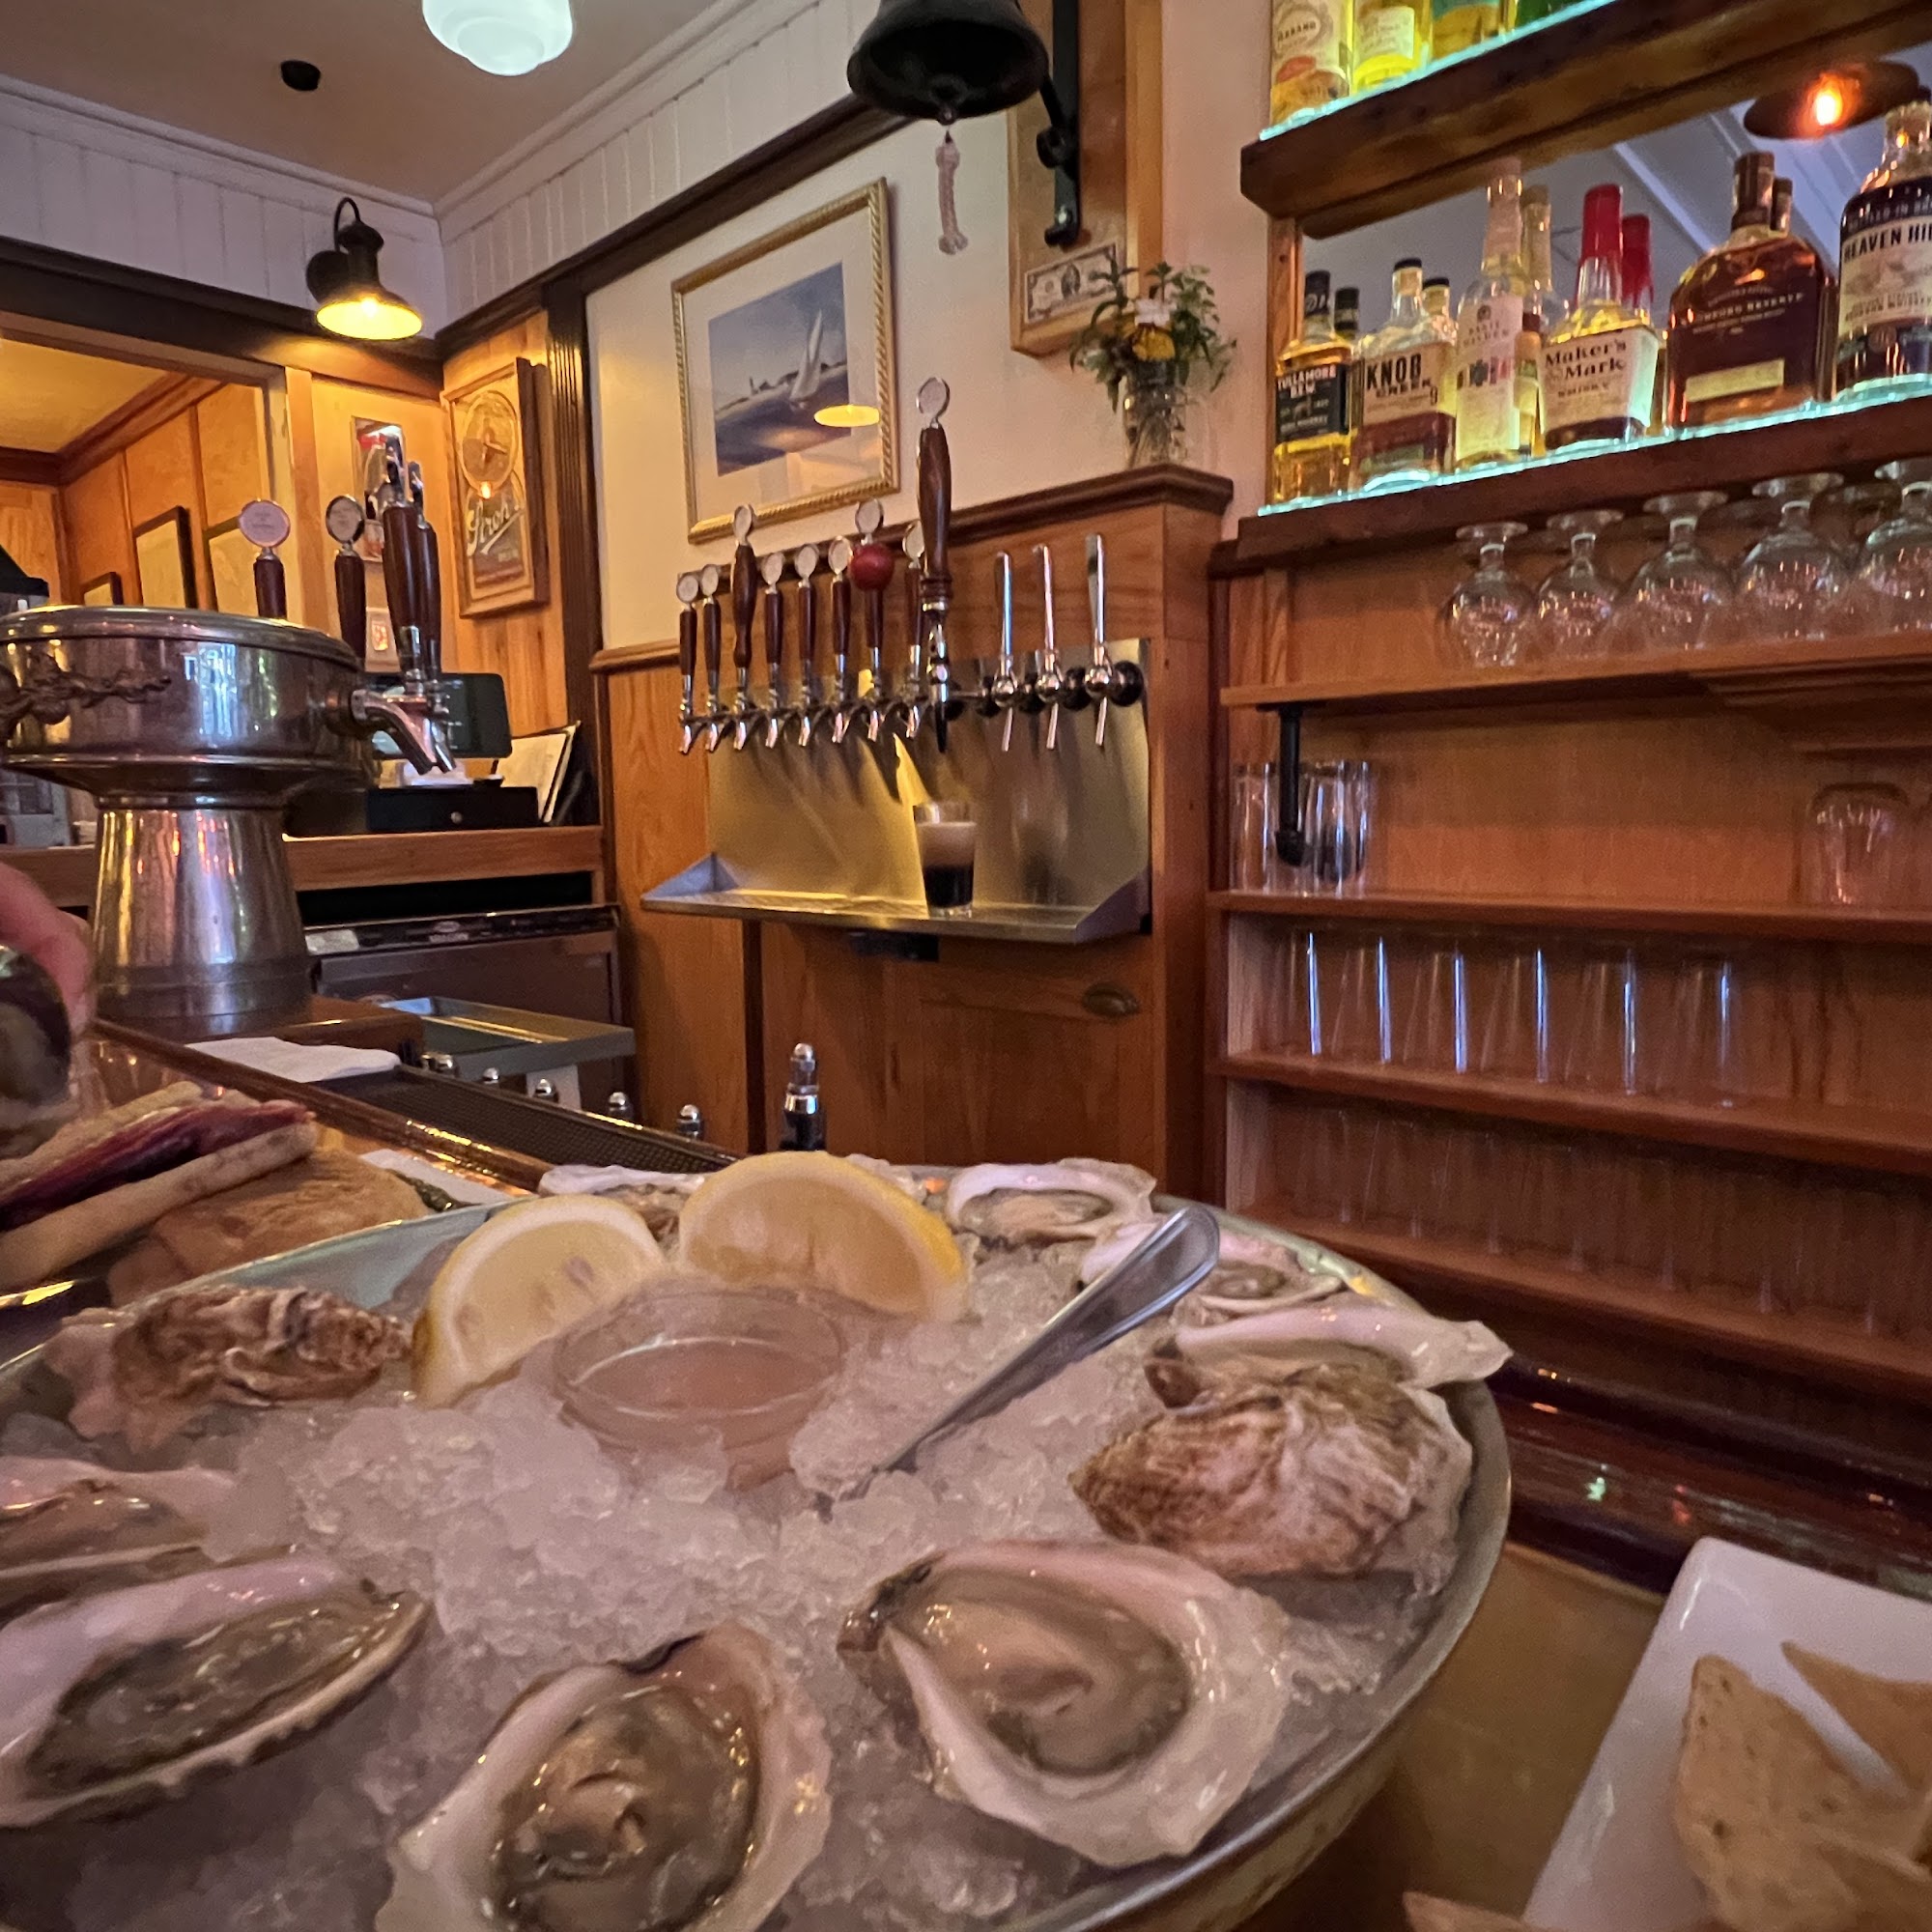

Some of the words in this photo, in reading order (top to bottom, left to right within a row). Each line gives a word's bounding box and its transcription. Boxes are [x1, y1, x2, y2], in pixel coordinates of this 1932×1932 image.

[1844, 226, 1902, 264] HEAVEN
[1367, 354, 1421, 391] KNOB
[1565, 357, 1626, 379] Mark
